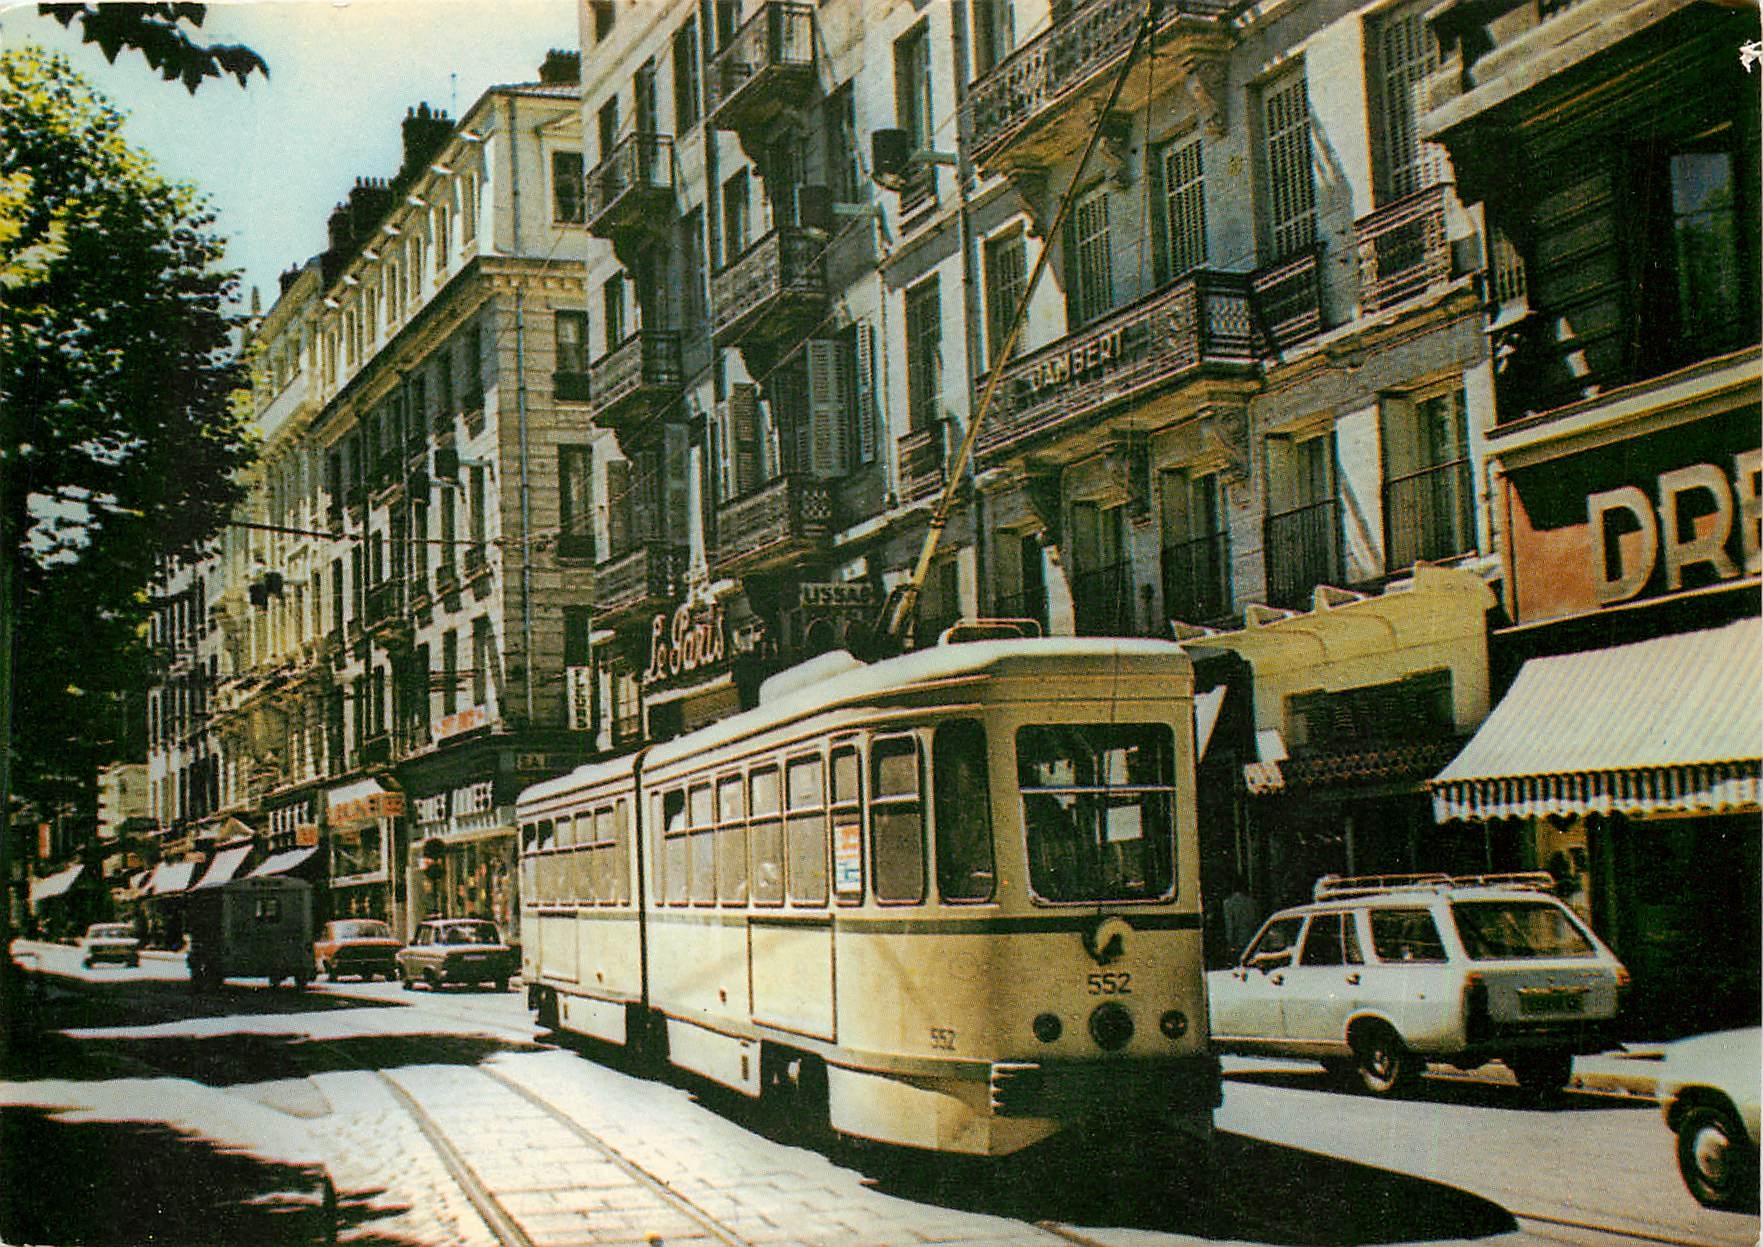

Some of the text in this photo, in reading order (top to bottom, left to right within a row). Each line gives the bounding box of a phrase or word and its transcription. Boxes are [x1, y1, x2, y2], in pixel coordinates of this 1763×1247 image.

[668, 602, 725, 676] Paris
[1087, 972, 1133, 995] 552
[929, 1026, 957, 1051] 552
